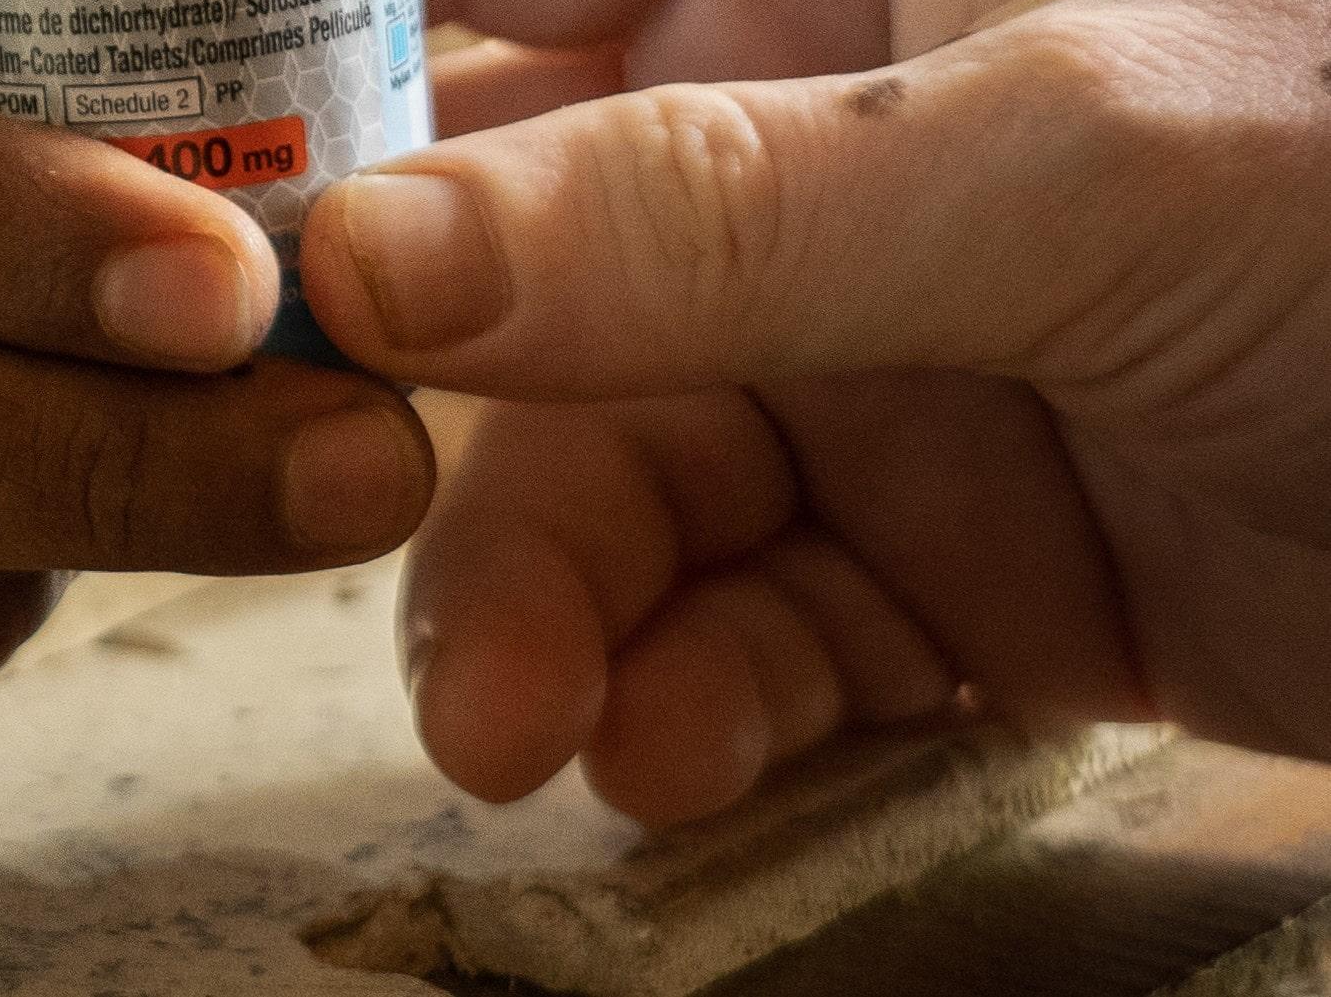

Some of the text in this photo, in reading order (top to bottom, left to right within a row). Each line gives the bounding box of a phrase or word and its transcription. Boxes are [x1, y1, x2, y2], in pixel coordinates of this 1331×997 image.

[39, 8, 63, 35] de
[76, 91, 169, 116] Schedule
[176, 88, 189, 109] 2
[216, 79, 243, 103] PP
[241, 143, 294, 173] mg
